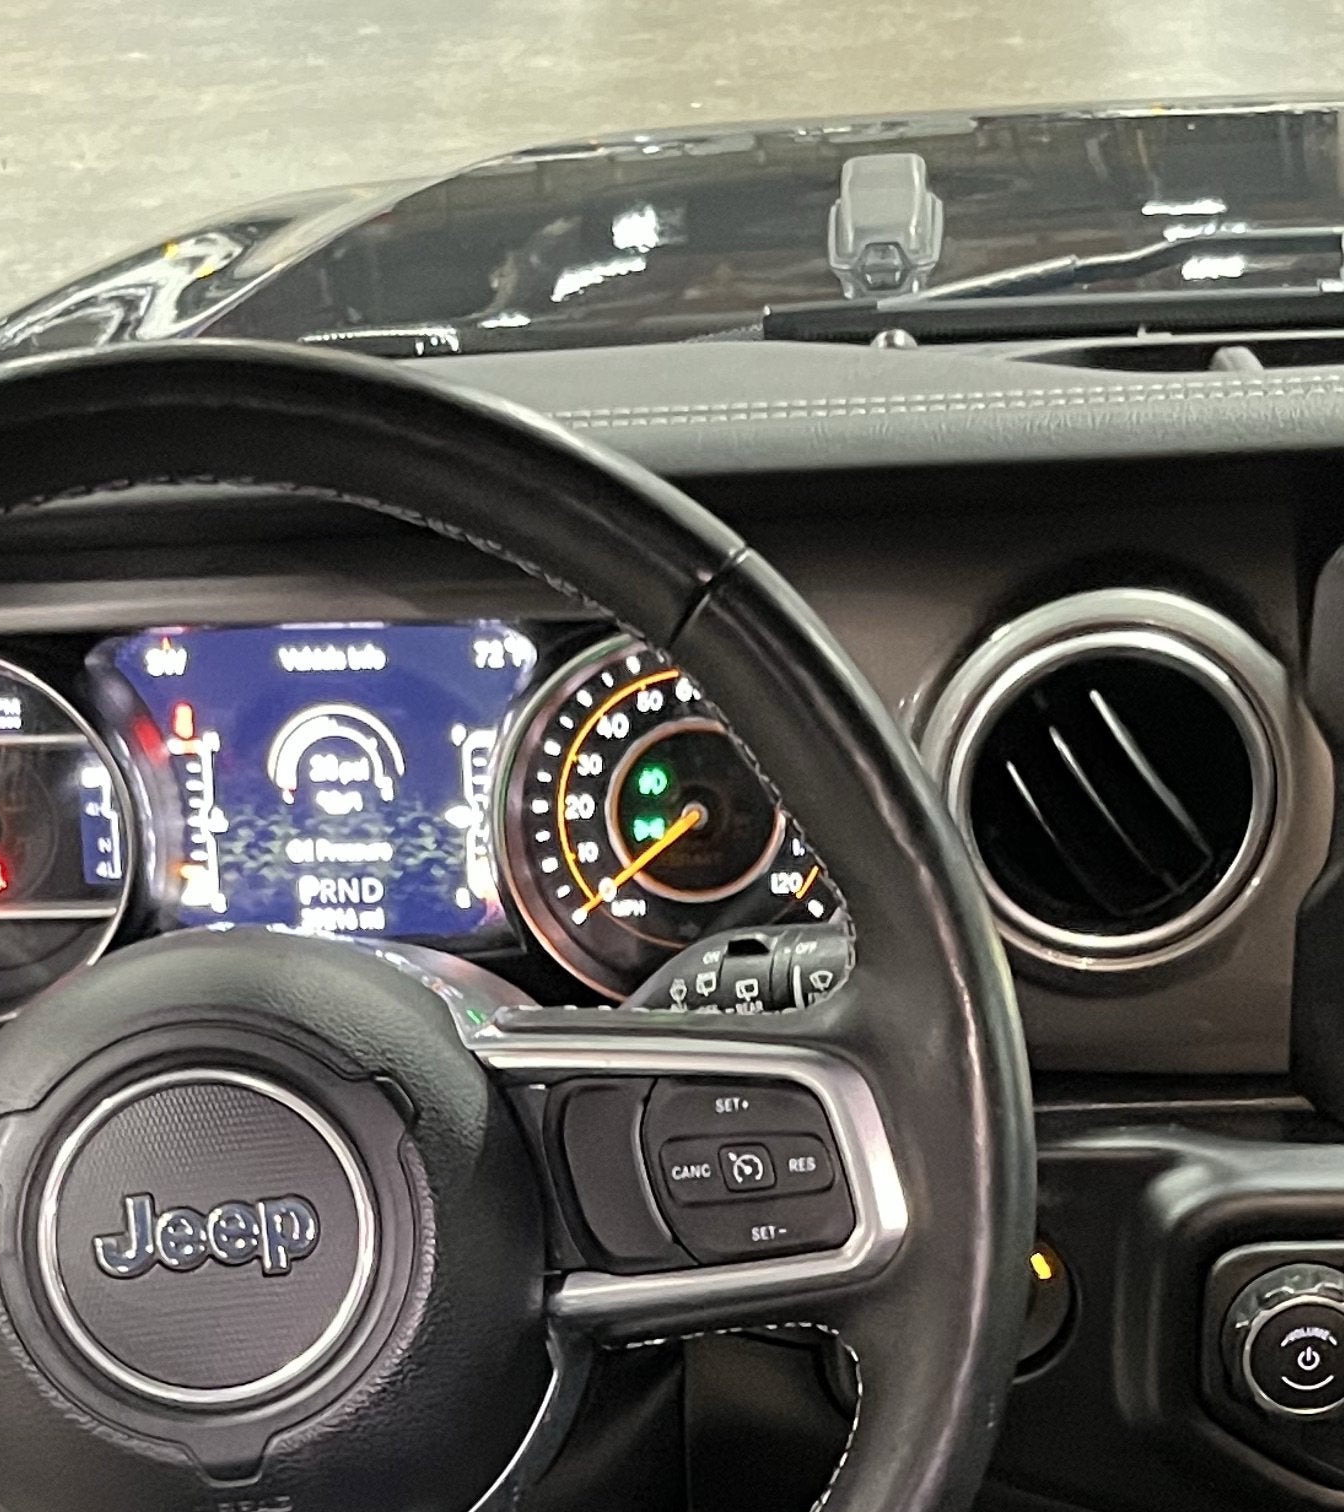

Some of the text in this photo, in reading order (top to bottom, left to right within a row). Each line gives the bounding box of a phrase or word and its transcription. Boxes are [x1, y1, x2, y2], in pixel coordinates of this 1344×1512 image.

[596, 711, 630, 740] 40
[576, 753, 603, 777] 30
[564, 793, 596, 820] 20
[577, 841, 599, 863] 10
[770, 871, 804, 895] 120
[703, 951, 724, 965] ON
[671, 1163, 712, 1181] CANC
[788, 1156, 817, 1173] RES
[93, 1192, 320, 1279] Jeep
